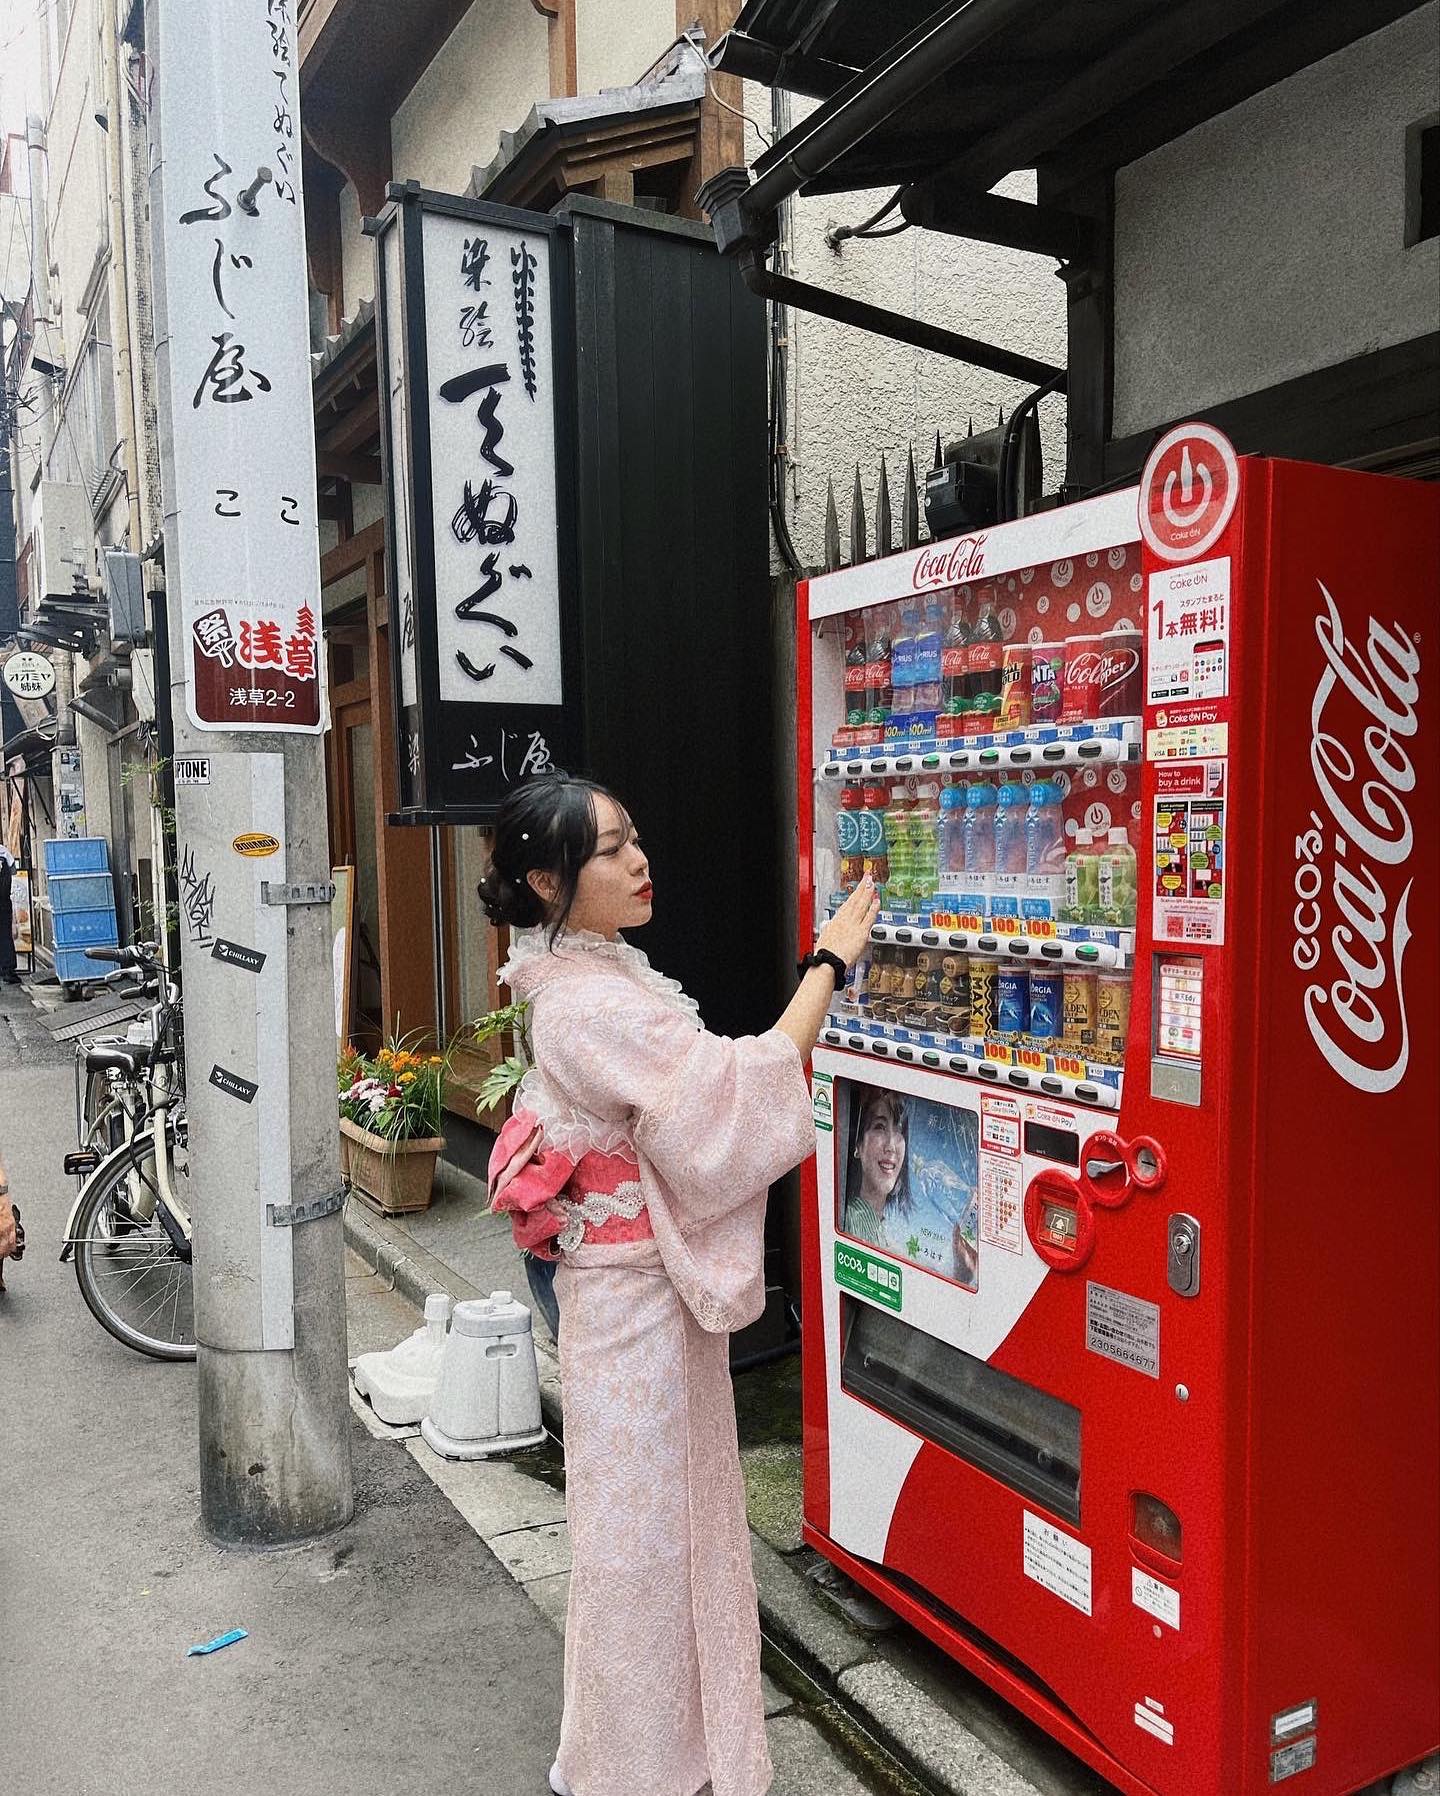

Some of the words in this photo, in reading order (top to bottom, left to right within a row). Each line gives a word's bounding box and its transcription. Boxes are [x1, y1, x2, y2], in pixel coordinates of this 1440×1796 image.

[912, 532, 990, 590] Coca-Cola
[1168, 578, 1193, 590] Coke
[239, 619, 315, 678] 浅草
[1032, 664, 1057, 685] NTA
[229, 688, 296, 708] 浅草2-2
[1169, 714, 1189, 724] Coke
[1202, 711, 1218, 723] Pay
[451, 727, 556, 784] ふじ屋
[174, 761, 208, 779] PTONE
[1158, 770, 1173, 778] How
[1158, 779, 1173, 788] buy
[1180, 776, 1201, 786] drink
[1303, 576, 1421, 1094] Coca-Cola
[234, 838, 278, 851] BOURBON
[227, 949, 260, 966] CHILLAXY
[999, 981, 1018, 991] RGIA
[1064, 1003, 1088, 1013] LDEN
[1099, 1009, 1120, 1020] LDEN
[221, 1077, 251, 1096] CHILLAXY
